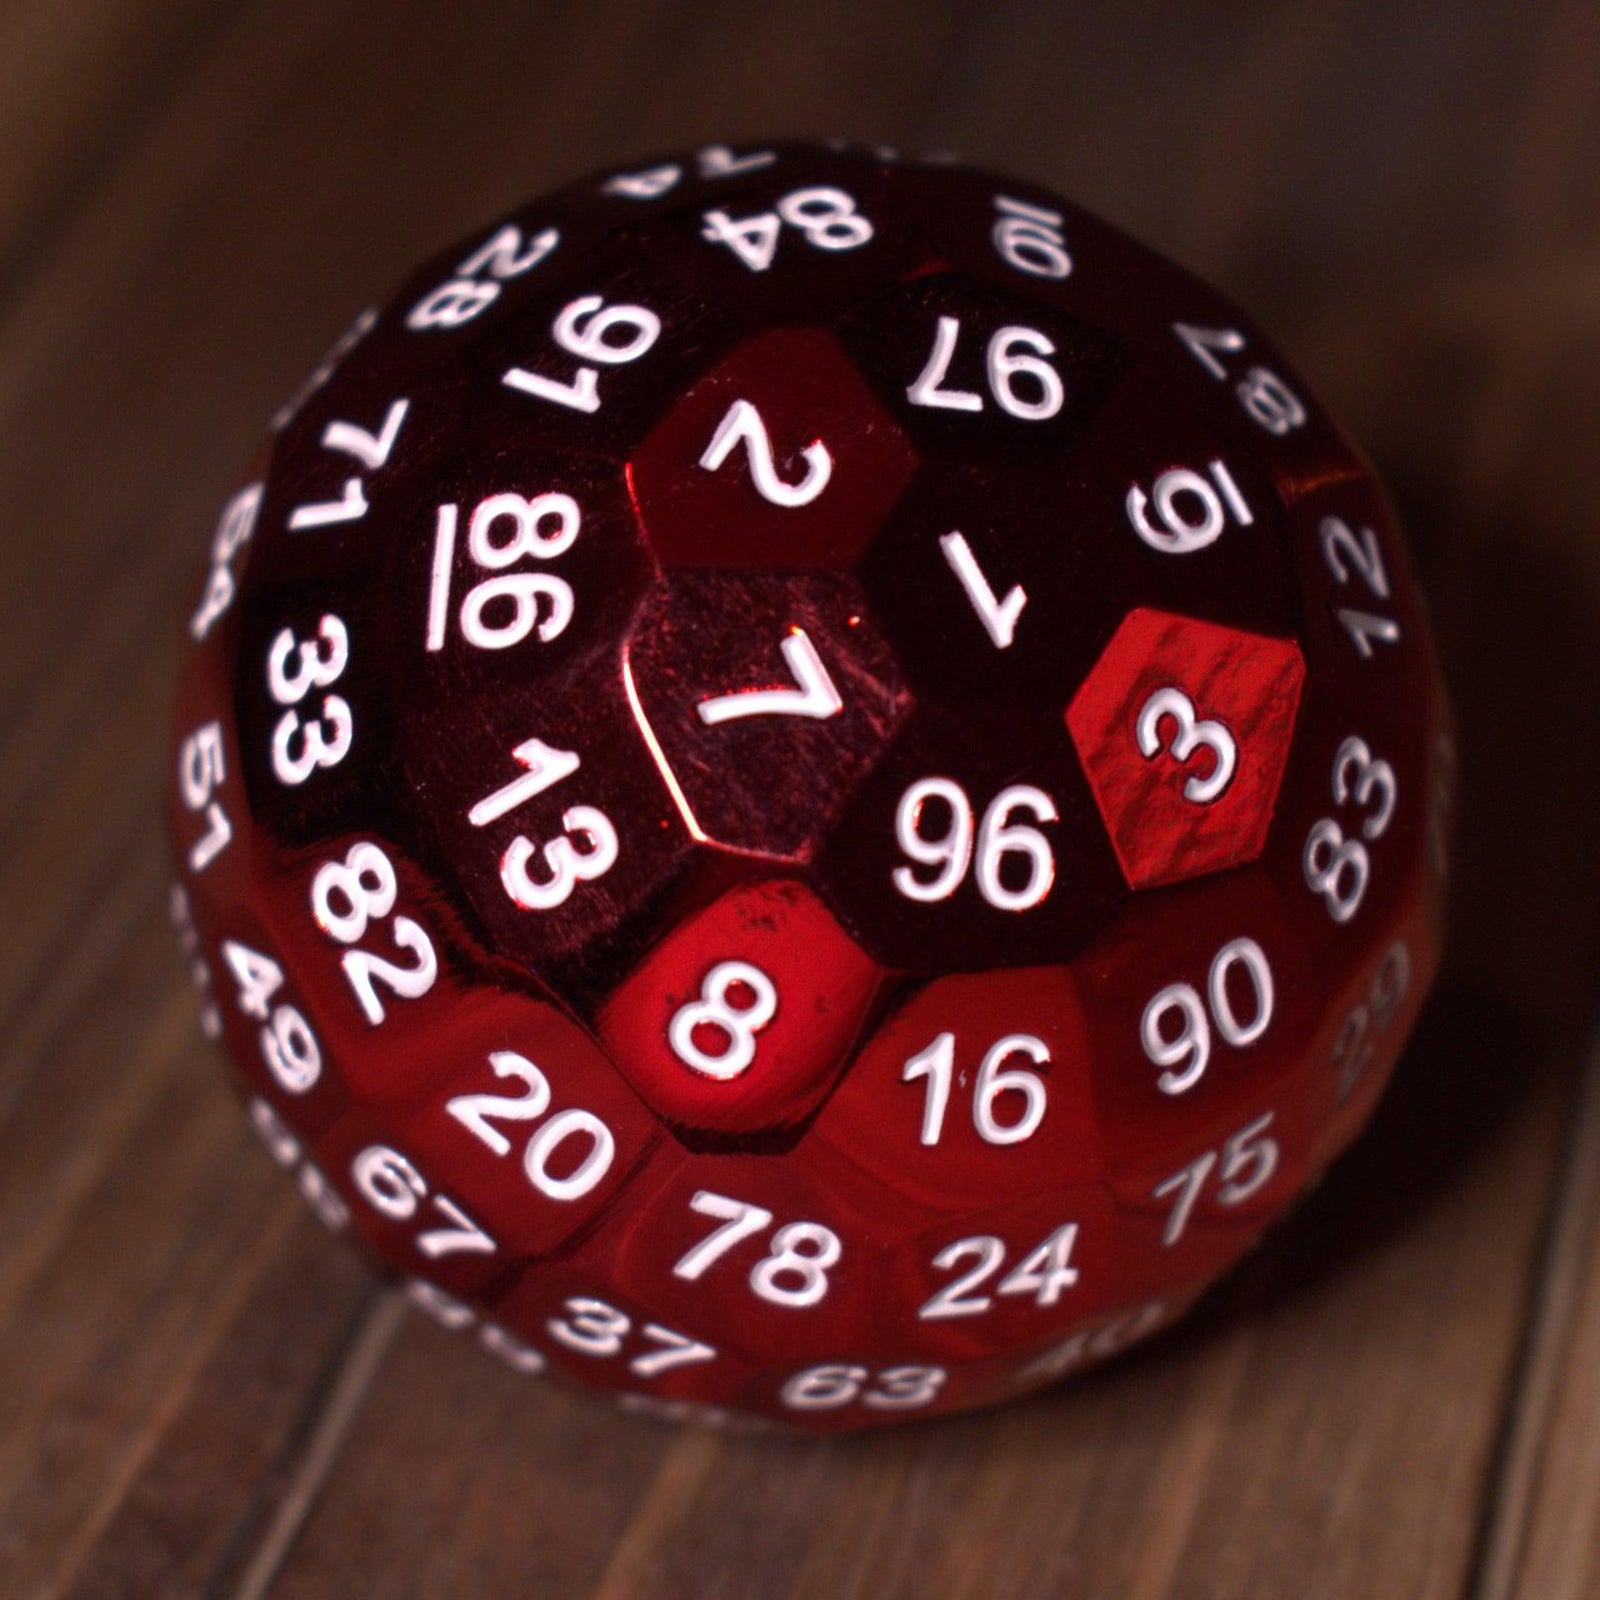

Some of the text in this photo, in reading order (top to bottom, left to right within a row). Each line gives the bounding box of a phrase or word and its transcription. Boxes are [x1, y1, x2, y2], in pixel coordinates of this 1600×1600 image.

[406, 225, 560, 330] 28
[703, 187, 874, 273] 84
[502, 295, 661, 414] 91
[907, 316, 1064, 421] 97
[1173, 322, 1306, 435] 87
[289, 399, 409, 530] 71
[699, 399, 832, 508] 2
[1126, 460, 1254, 553] 6
[426, 491, 581, 652] 86
[940, 531, 1027, 649] 1
[1322, 515, 1400, 658] 12
[268, 614, 353, 785] 33
[698, 628, 843, 723] 7
[179, 721, 233, 871] 51
[1137, 688, 1236, 802] 3
[467, 737, 619, 910] 13
[893, 778, 1059, 911] 96
[1303, 735, 1398, 922] 83
[310, 841, 438, 1026] 82
[223, 940, 322, 1093] 49
[669, 961, 777, 1081] 8
[1141, 938, 1274, 1095] 90
[446, 1050, 616, 1202] 20
[903, 1032, 1051, 1146] 16
[353, 1144, 498, 1257] 67
[1153, 1111, 1279, 1246] 75
[673, 1190, 842, 1308] 78
[919, 1223, 1079, 1319] 24
[548, 1297, 716, 1376] 37
[781, 1364, 948, 1410] 63
